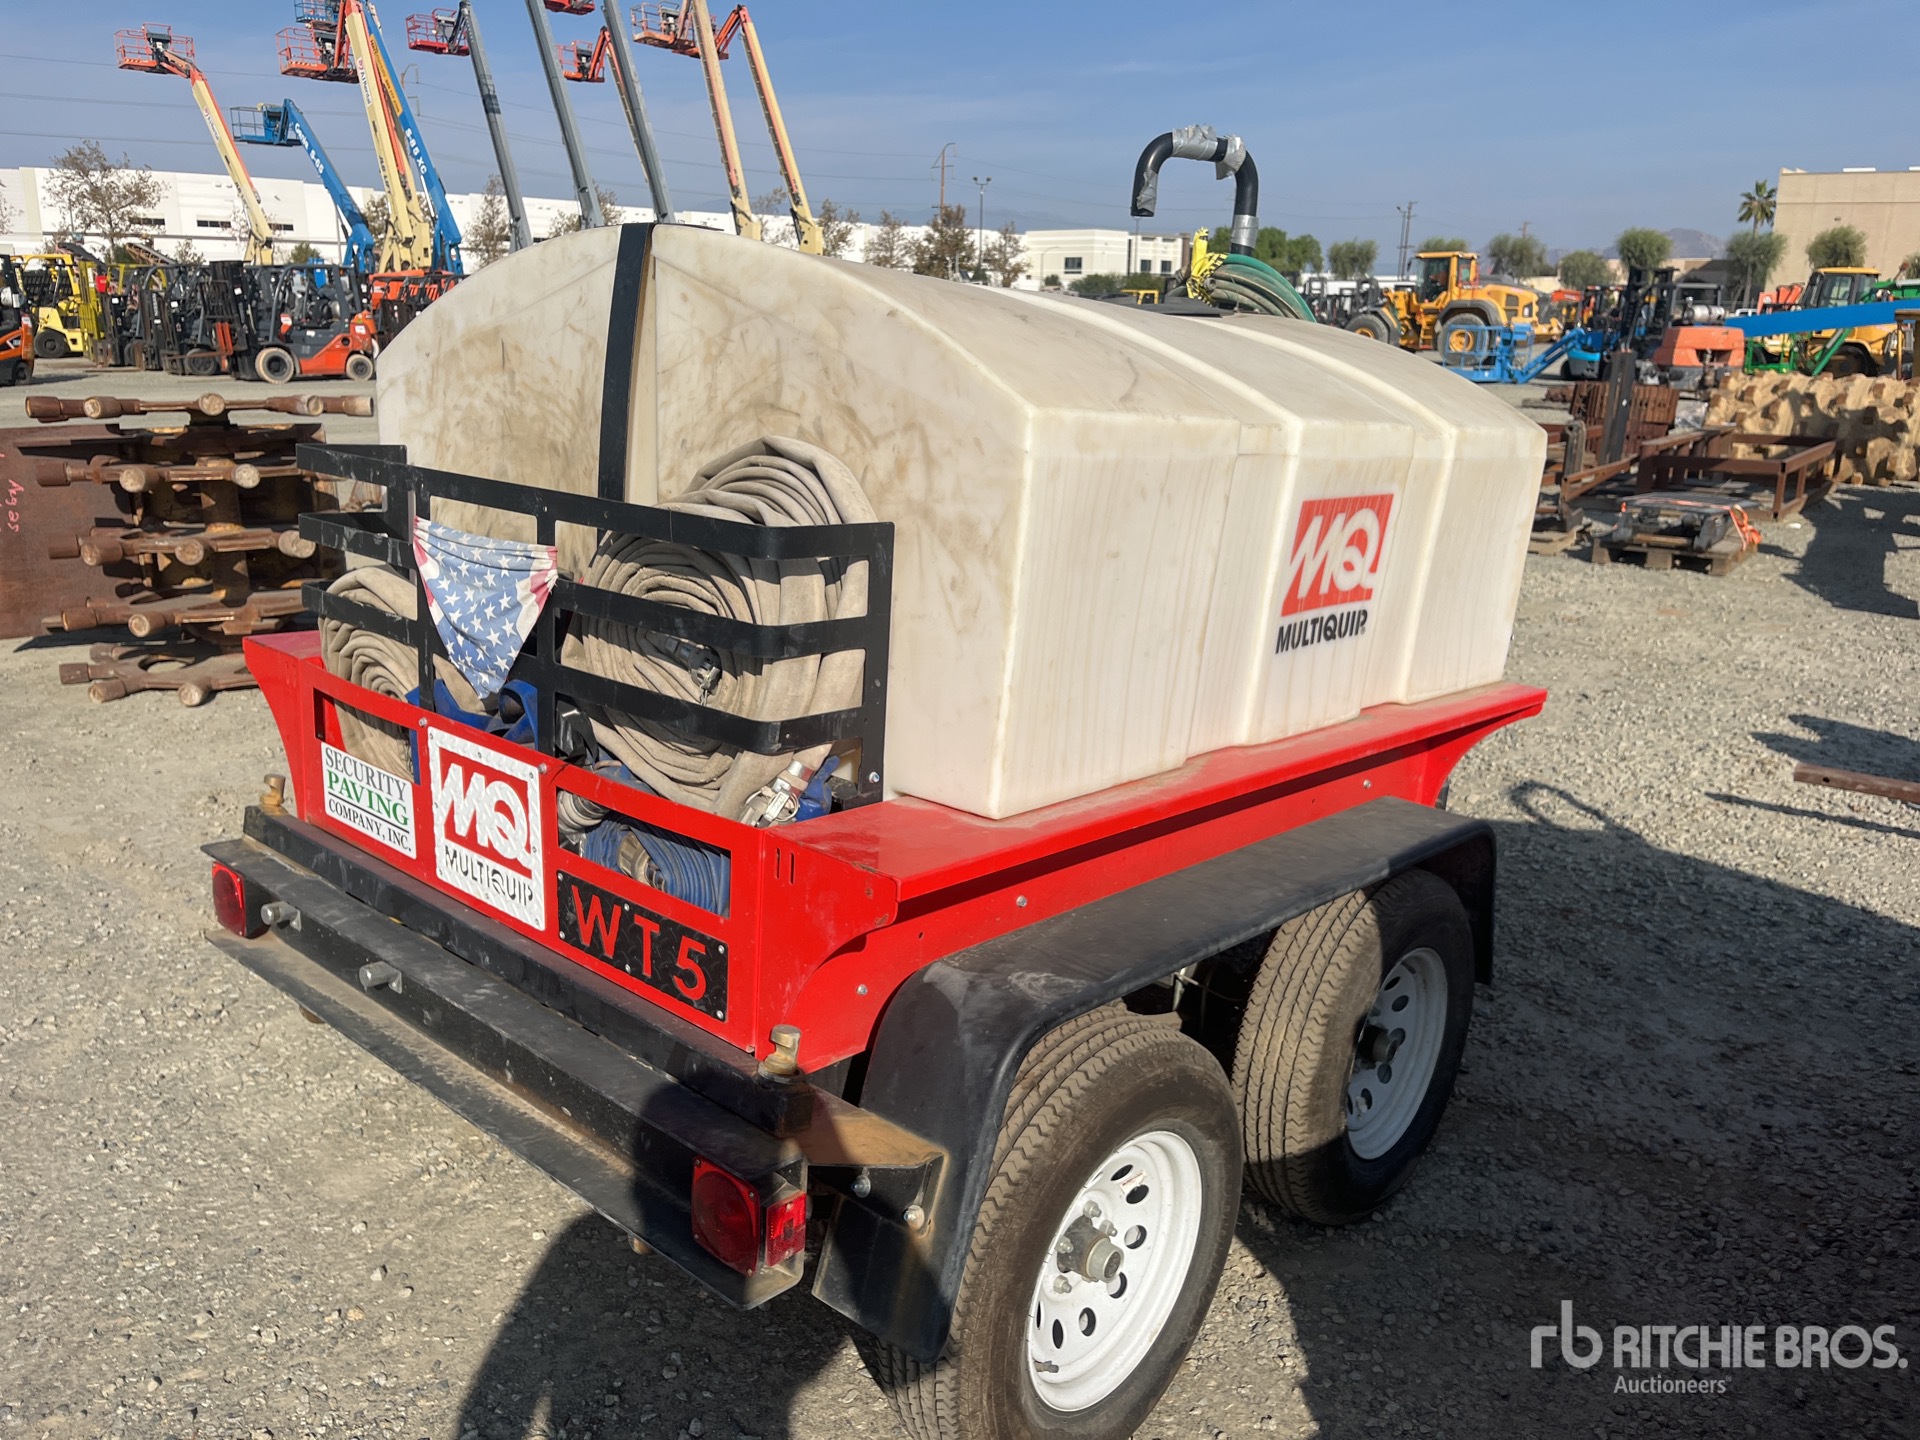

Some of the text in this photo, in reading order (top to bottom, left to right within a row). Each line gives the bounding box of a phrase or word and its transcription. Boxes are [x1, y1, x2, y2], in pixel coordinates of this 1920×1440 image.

[416, 156, 427, 174] XC
[1284, 507, 1379, 599] MQ
[325, 747, 407, 801] SECURITY
[327, 769, 409, 827] PAVING
[329, 799, 412, 852] COMPANY, INC.
[440, 763, 532, 869] MQ
[445, 845, 533, 906] MULTIQUIP
